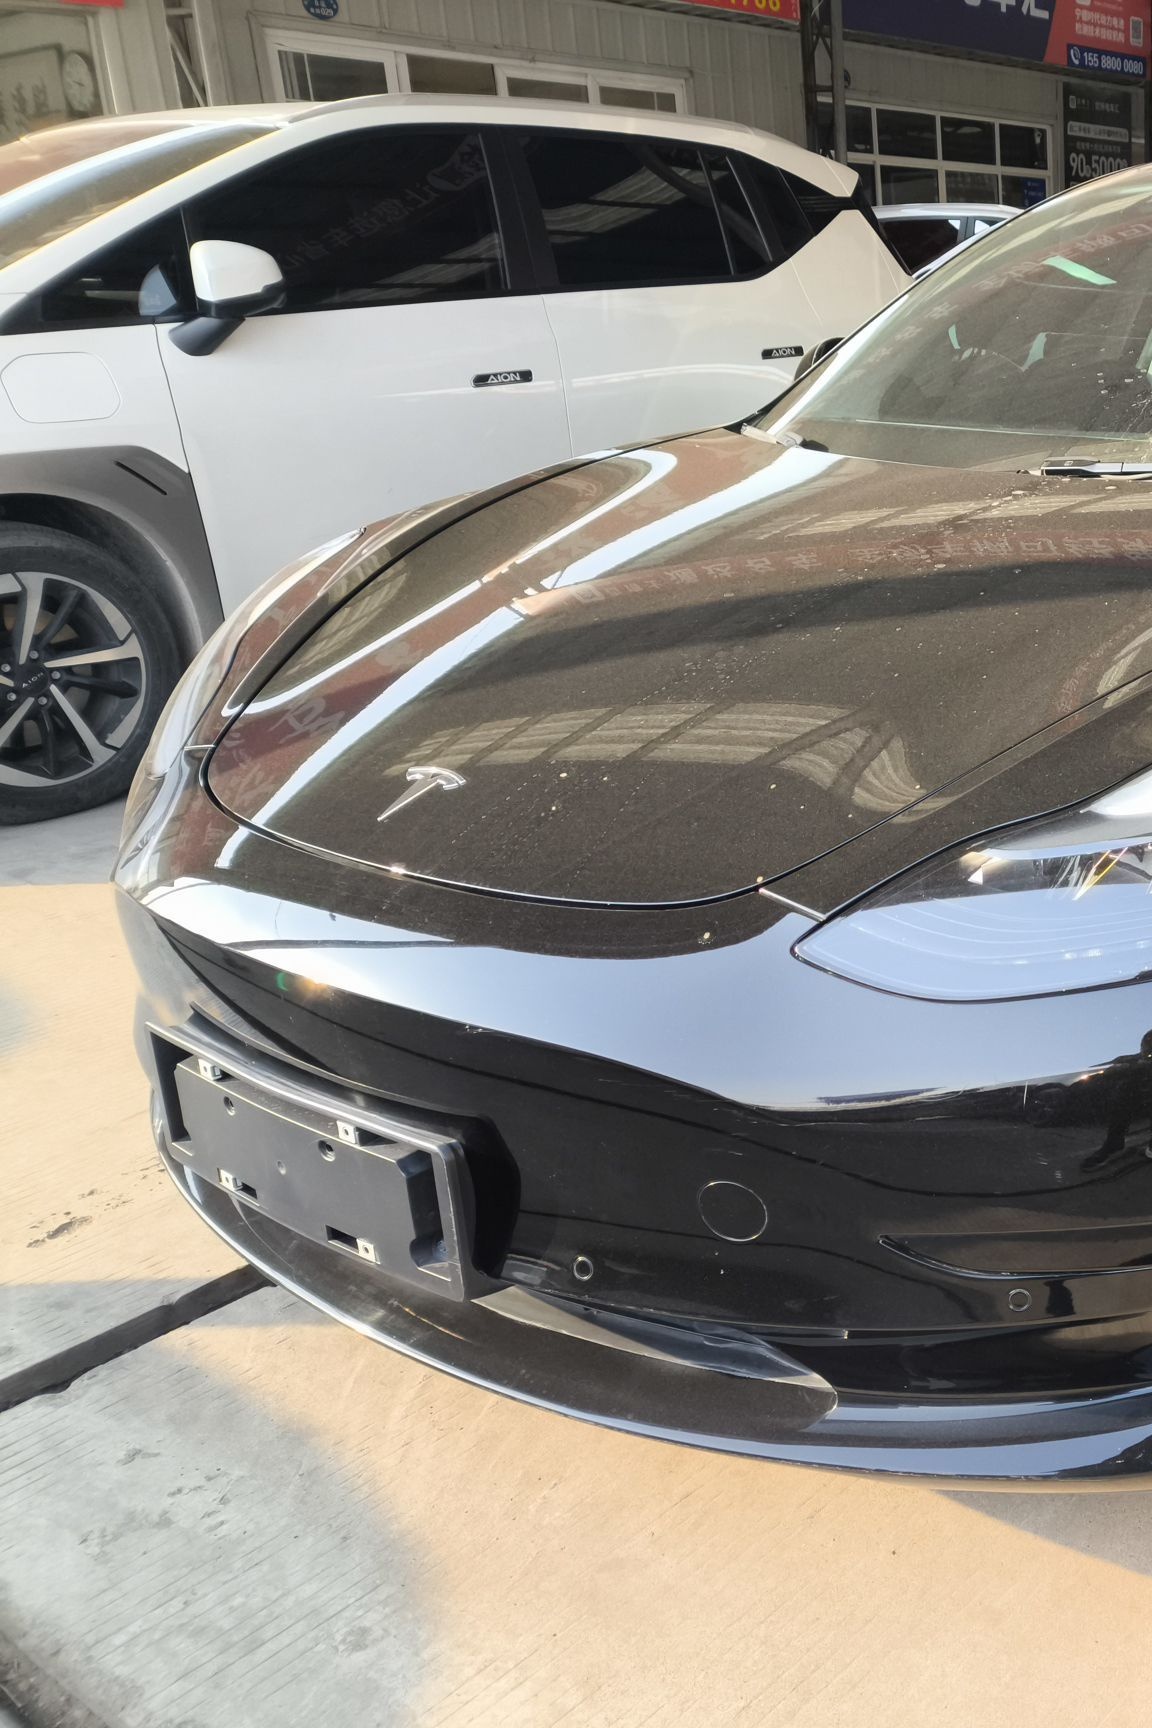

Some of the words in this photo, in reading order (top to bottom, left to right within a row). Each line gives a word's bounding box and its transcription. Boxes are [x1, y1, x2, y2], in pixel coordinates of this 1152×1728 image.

[1083, 51, 1099, 67] 155
[1101, 54, 1122, 71] 8800
[1123, 58, 1144, 75] 0080
[771, 347, 796, 357] AION
[487, 372, 521, 383] AION
